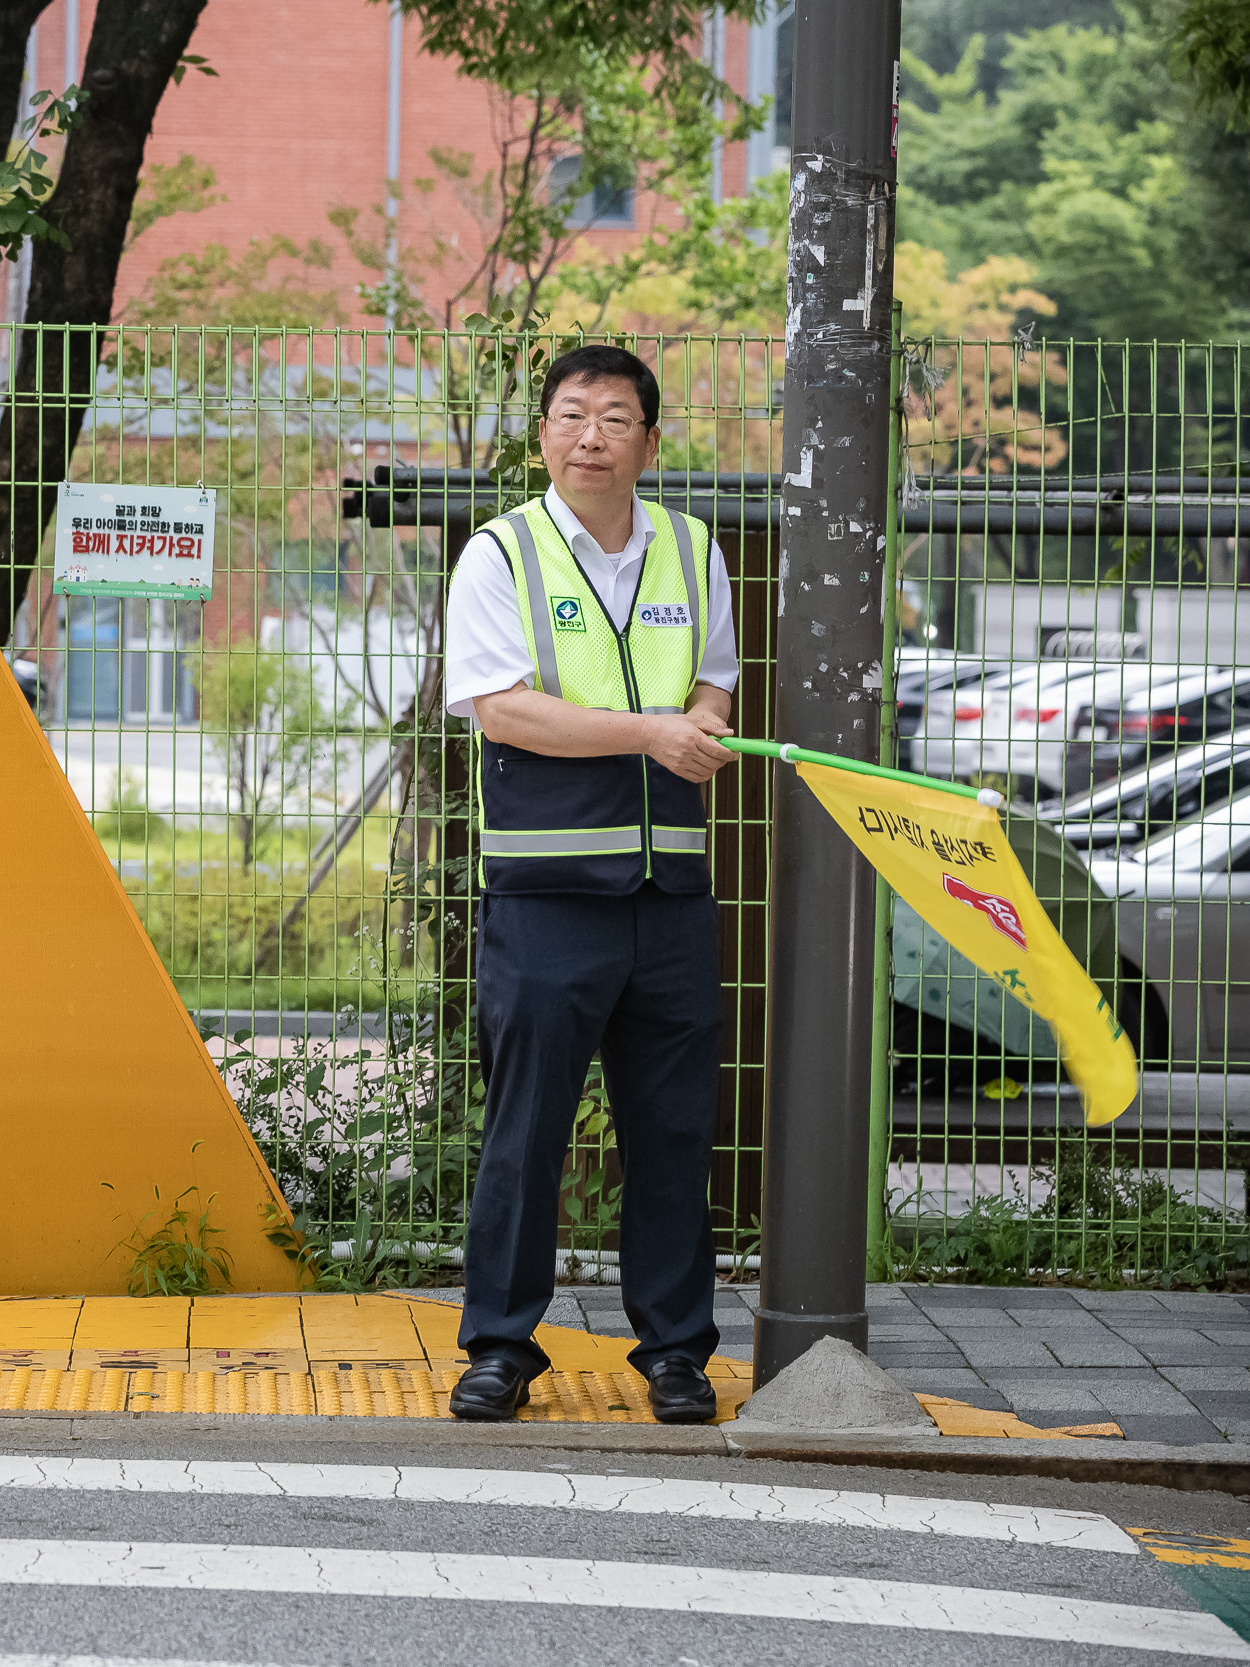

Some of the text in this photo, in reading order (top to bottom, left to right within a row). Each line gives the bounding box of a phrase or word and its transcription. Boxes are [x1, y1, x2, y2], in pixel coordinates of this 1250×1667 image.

[116, 505, 161, 517] 꿈과 희망
[72, 517, 92, 531] 우리
[95, 518, 137, 532] 아이들의
[139, 520, 170, 534] 안전한
[71, 530, 202, 560] 함께 지켜가요!
[558, 620, 582, 628] 광진구
[654, 616, 687, 624] 광진구청장
